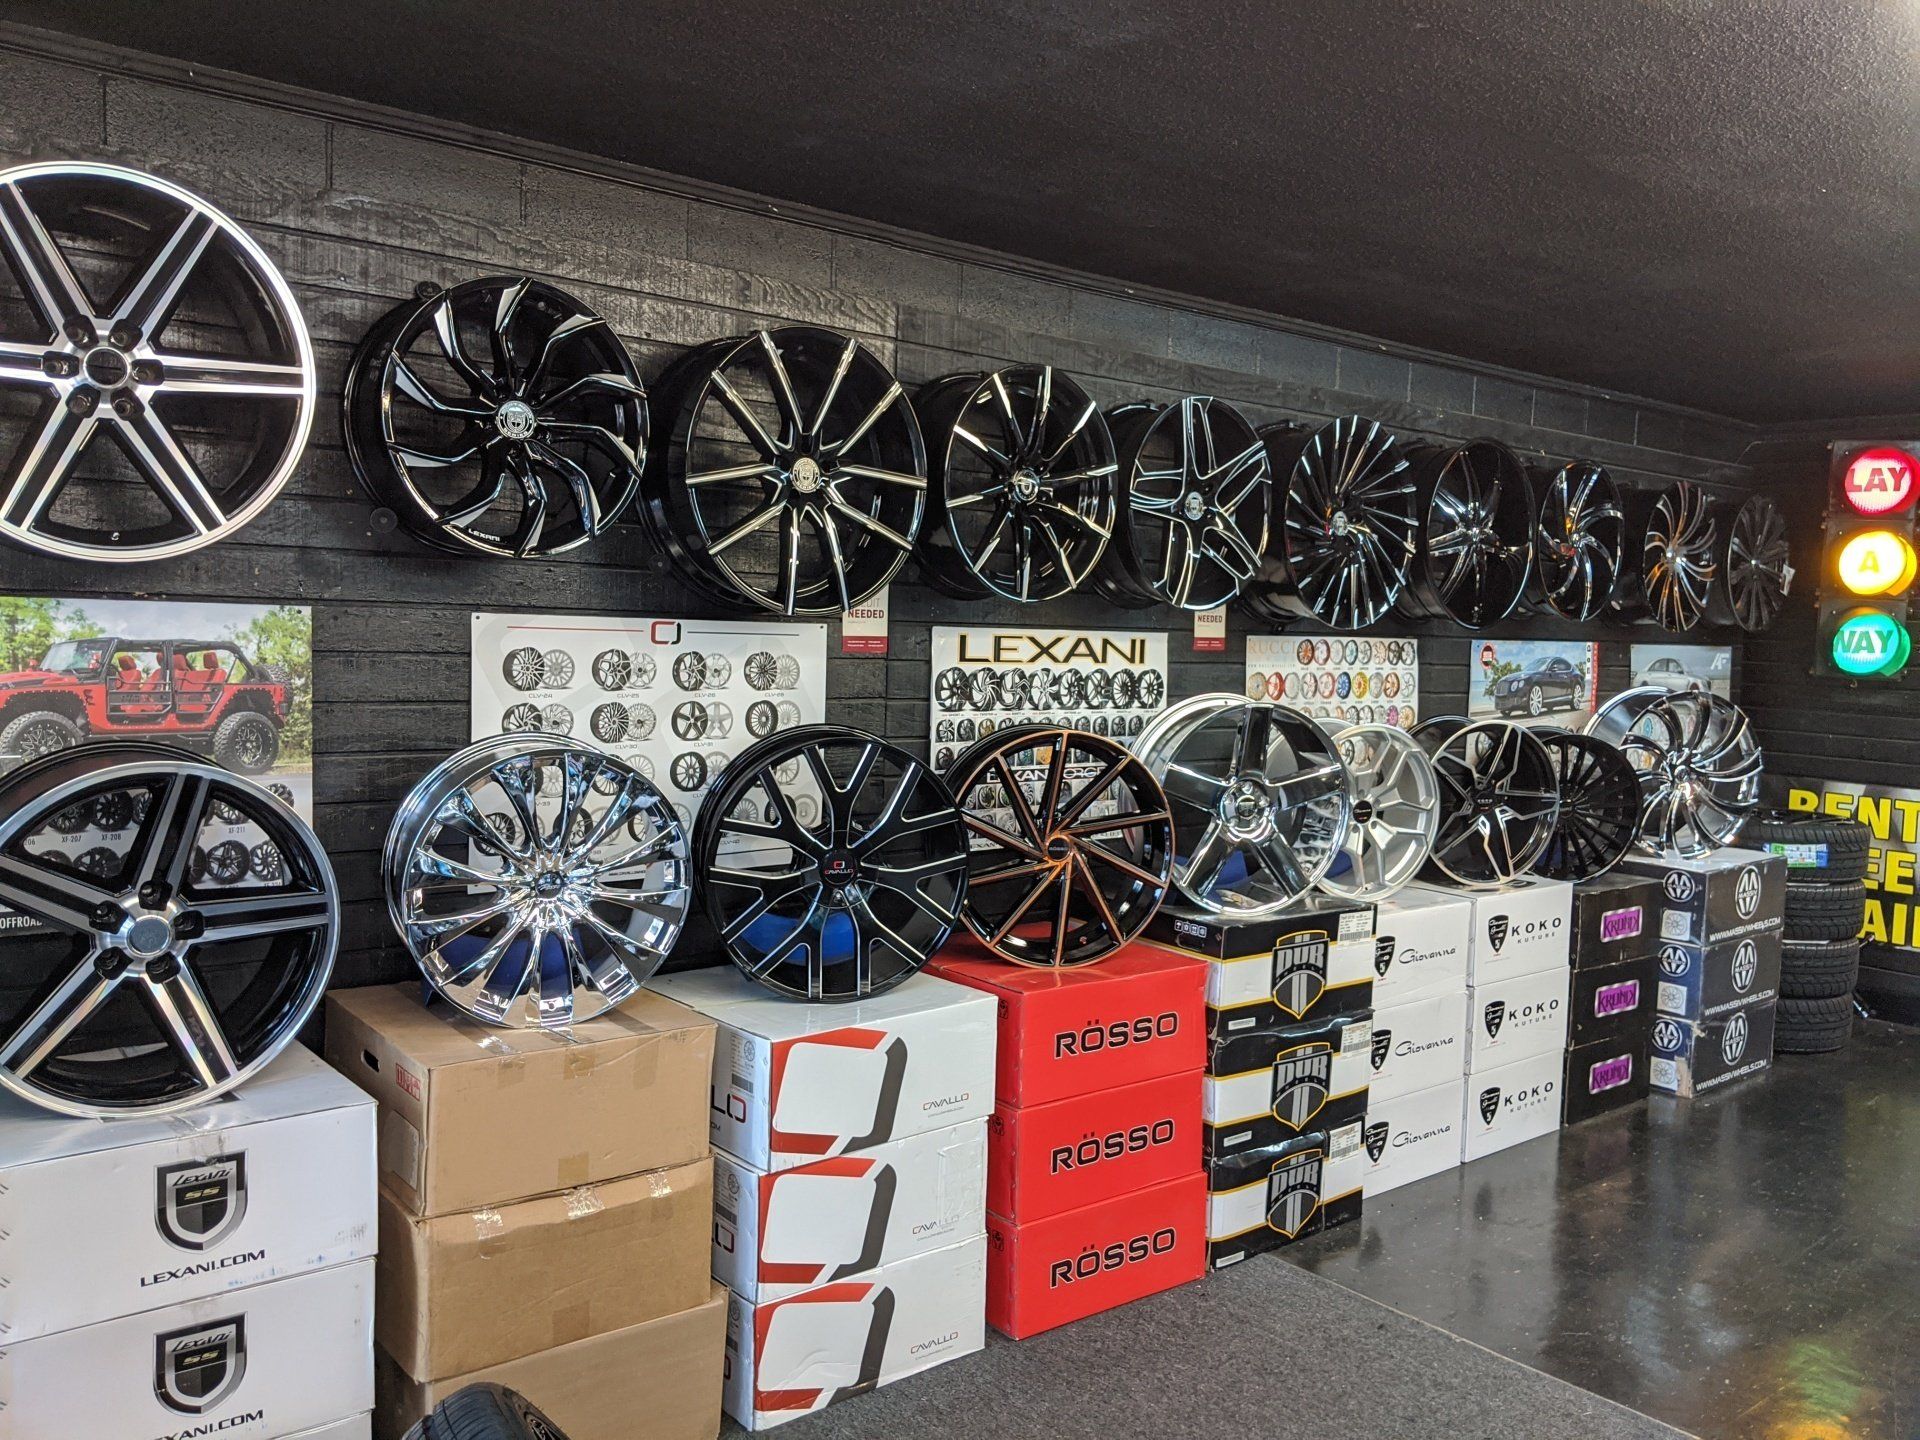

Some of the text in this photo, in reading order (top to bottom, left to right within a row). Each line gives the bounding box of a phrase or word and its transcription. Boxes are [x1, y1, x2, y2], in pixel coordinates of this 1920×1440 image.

[1845, 467, 1907, 493] LAY
[468, 528, 500, 541] LEXANI
[1858, 551, 1879, 573] A
[848, 609, 885, 619] NEEDED
[1197, 615, 1223, 623] NEEDED
[958, 634, 1146, 664] LEXANI
[1248, 640, 1296, 656] RUCCI
[1511, 917, 1562, 937] KOKO
[1275, 943, 1325, 978] DUB
[1399, 948, 1456, 964] Giovanna
[1508, 999, 1559, 1021] KOKO
[1054, 1011, 1179, 1060] RÖSSO
[1395, 1037, 1454, 1056] Giovanna
[1276, 1055, 1328, 1093] DUB
[923, 1093, 969, 1111] CAVALLO
[1504, 1082, 1553, 1107] KOKO
[1050, 1118, 1174, 1175] RÖSSO
[1392, 1125, 1451, 1147] Giovanna
[1271, 1161, 1319, 1203] DUB
[912, 1215, 959, 1235] CAVALLO
[140, 1249, 266, 1287] LEXANI.COM
[1050, 1227, 1176, 1288] RÖSSO
[910, 1331, 959, 1354] CAVALLO
